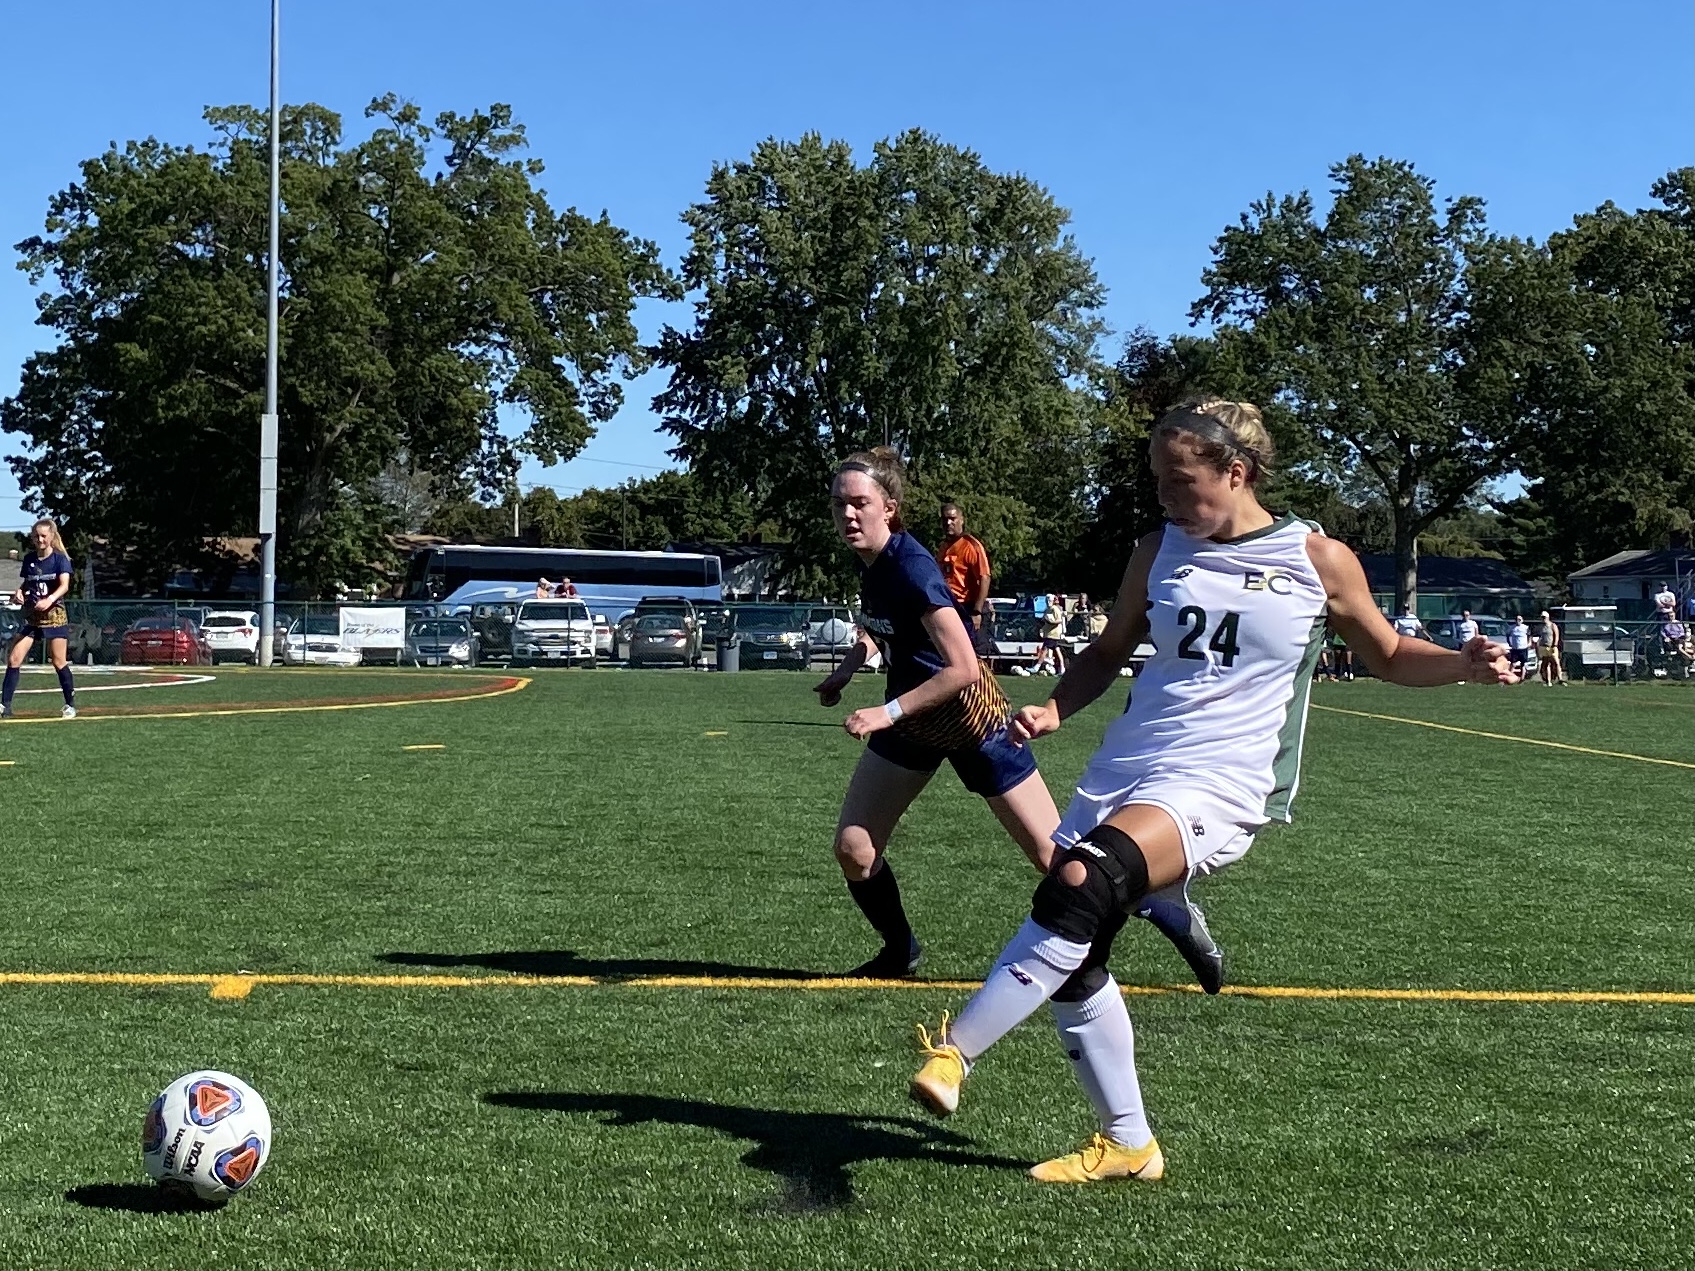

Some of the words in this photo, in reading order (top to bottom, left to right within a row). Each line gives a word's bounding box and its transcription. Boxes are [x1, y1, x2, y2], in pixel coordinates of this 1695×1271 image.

[1176, 604, 1241, 668] 24
[163, 1127, 187, 1170] Wilson
[183, 1140, 206, 1177] NCAA
